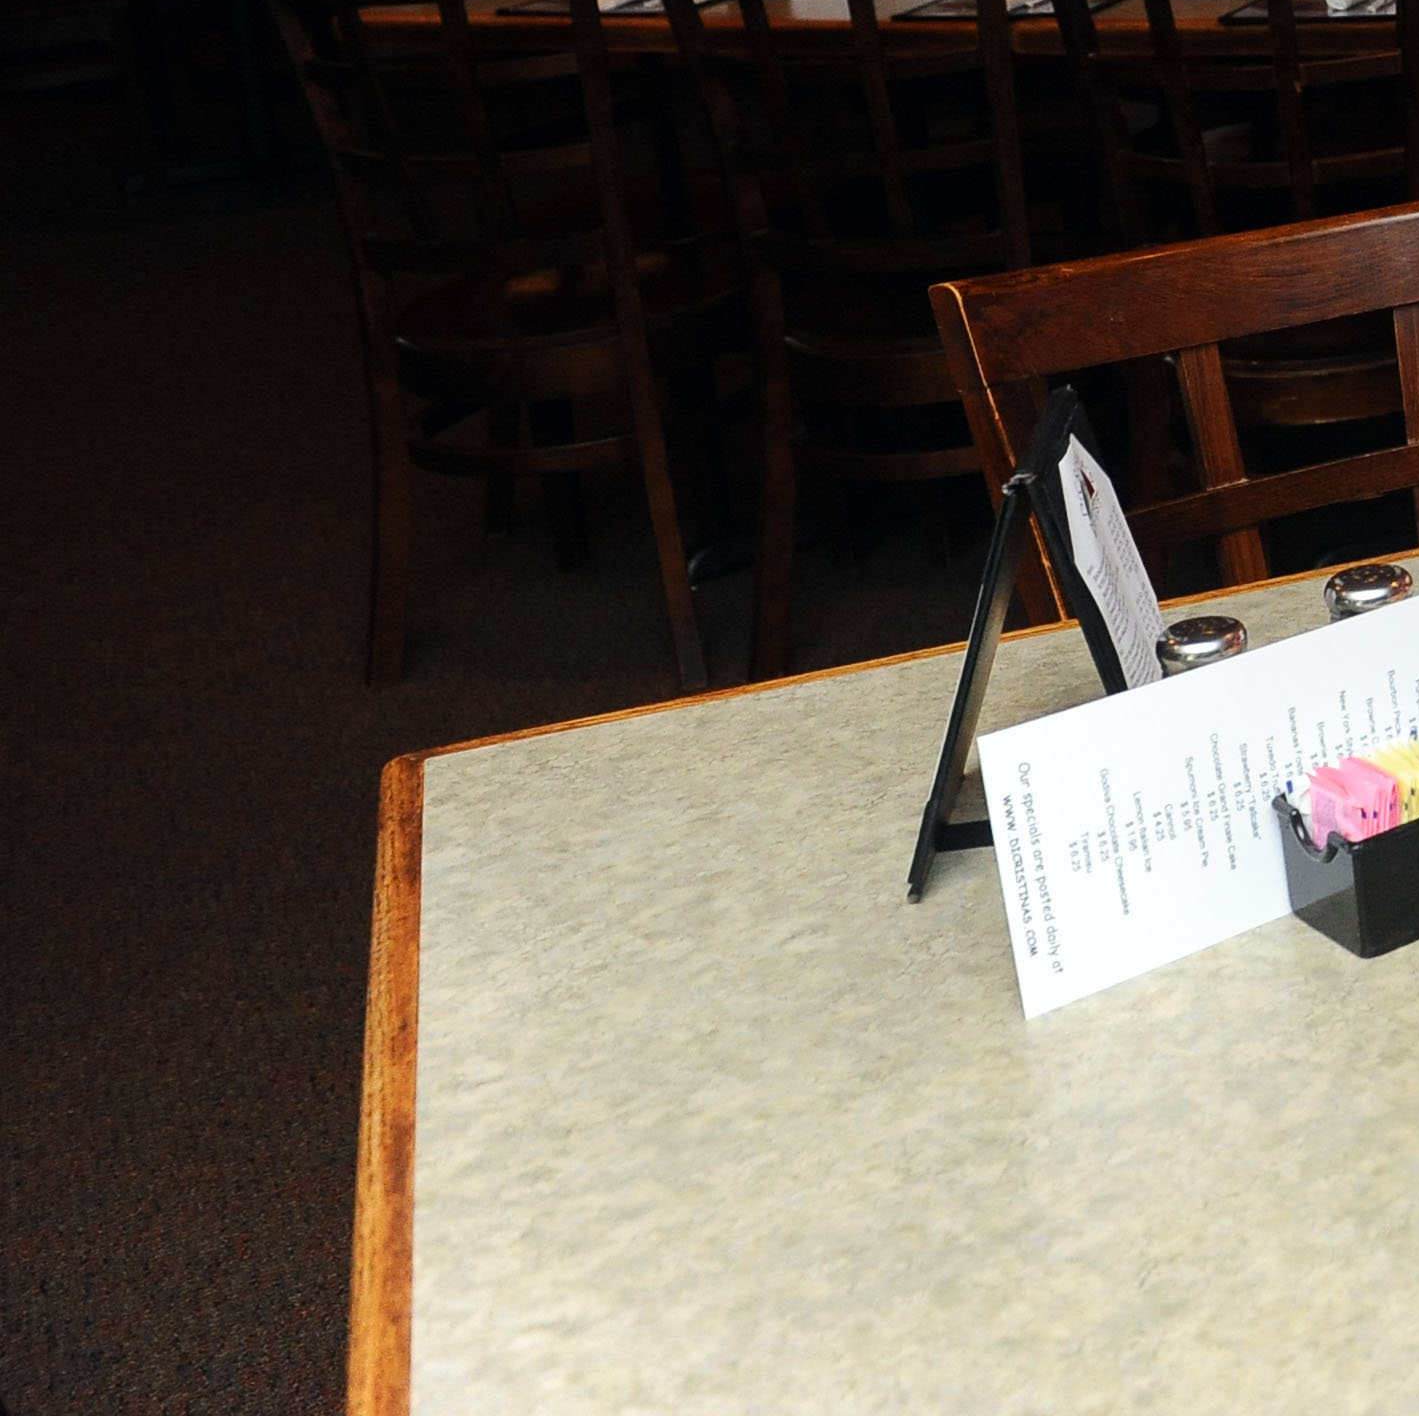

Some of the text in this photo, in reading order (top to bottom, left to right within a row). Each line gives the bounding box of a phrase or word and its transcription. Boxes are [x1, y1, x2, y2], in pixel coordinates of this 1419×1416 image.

[1387, 669, 1398, 708] Bourbon
[1287, 706, 1299, 748] Bananas
[1342, 713, 1351, 734] York
[1365, 696, 1376, 734] Brownie
[1265, 735, 1276, 771] Tuxedo
[1316, 720, 1327, 759] Brownie
[1239, 742, 1252, 793] Strawberry
[1163, 803, 1177, 840] Cannoli
[1184, 756, 1209, 867] Spumoni Ice Cream Pie
[1209, 732, 1237, 870] Chocolate Grand Finale Cake
[1081, 831, 1092, 874] Tiramisu
[1099, 768, 1130, 915] Godiva Chocolate Cheesecake
[1132, 791, 1152, 872] Lemon Italian Ice
[1017, 761, 1064, 973] Our specials are posted daily at
